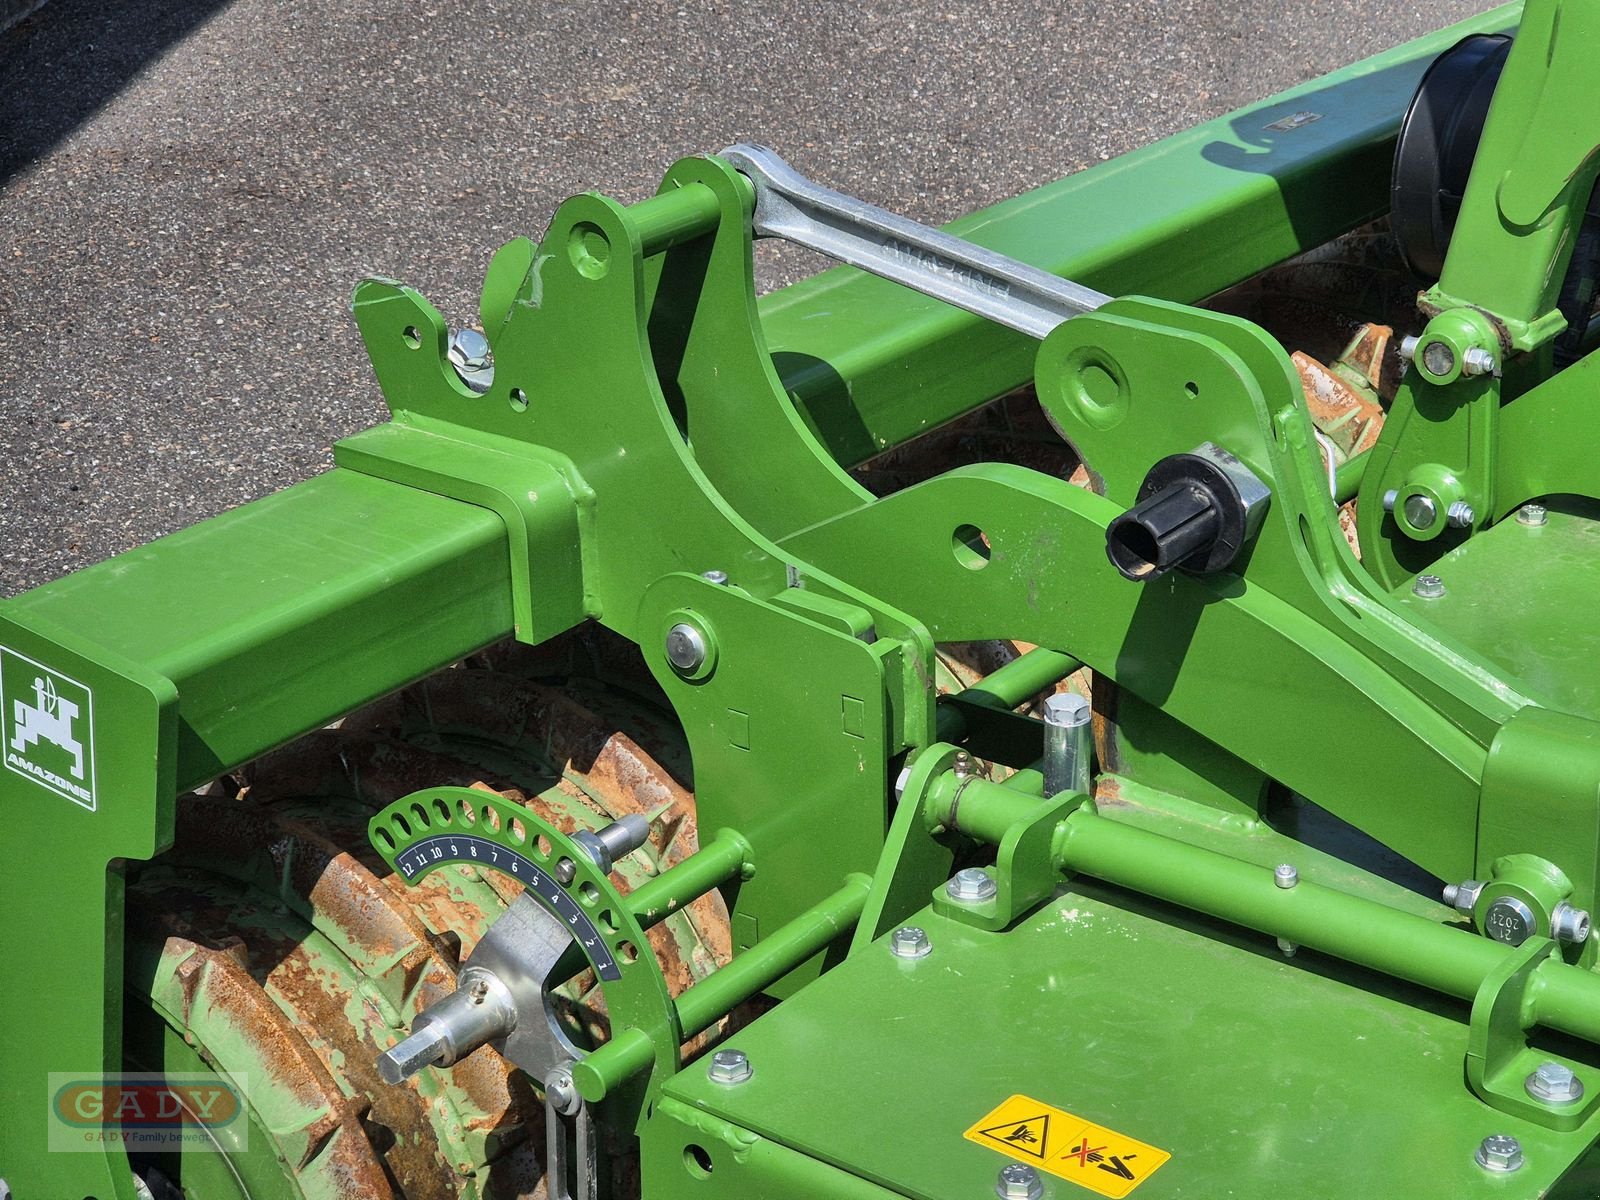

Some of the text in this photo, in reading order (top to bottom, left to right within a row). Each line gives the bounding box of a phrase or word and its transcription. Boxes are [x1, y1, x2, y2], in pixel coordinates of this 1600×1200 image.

[7, 753, 92, 802] AMAZONE
[402, 844, 608, 971] 12 11 10 9 8 7 6 5 4 3 2 1
[1499, 928, 1512, 941] 21
